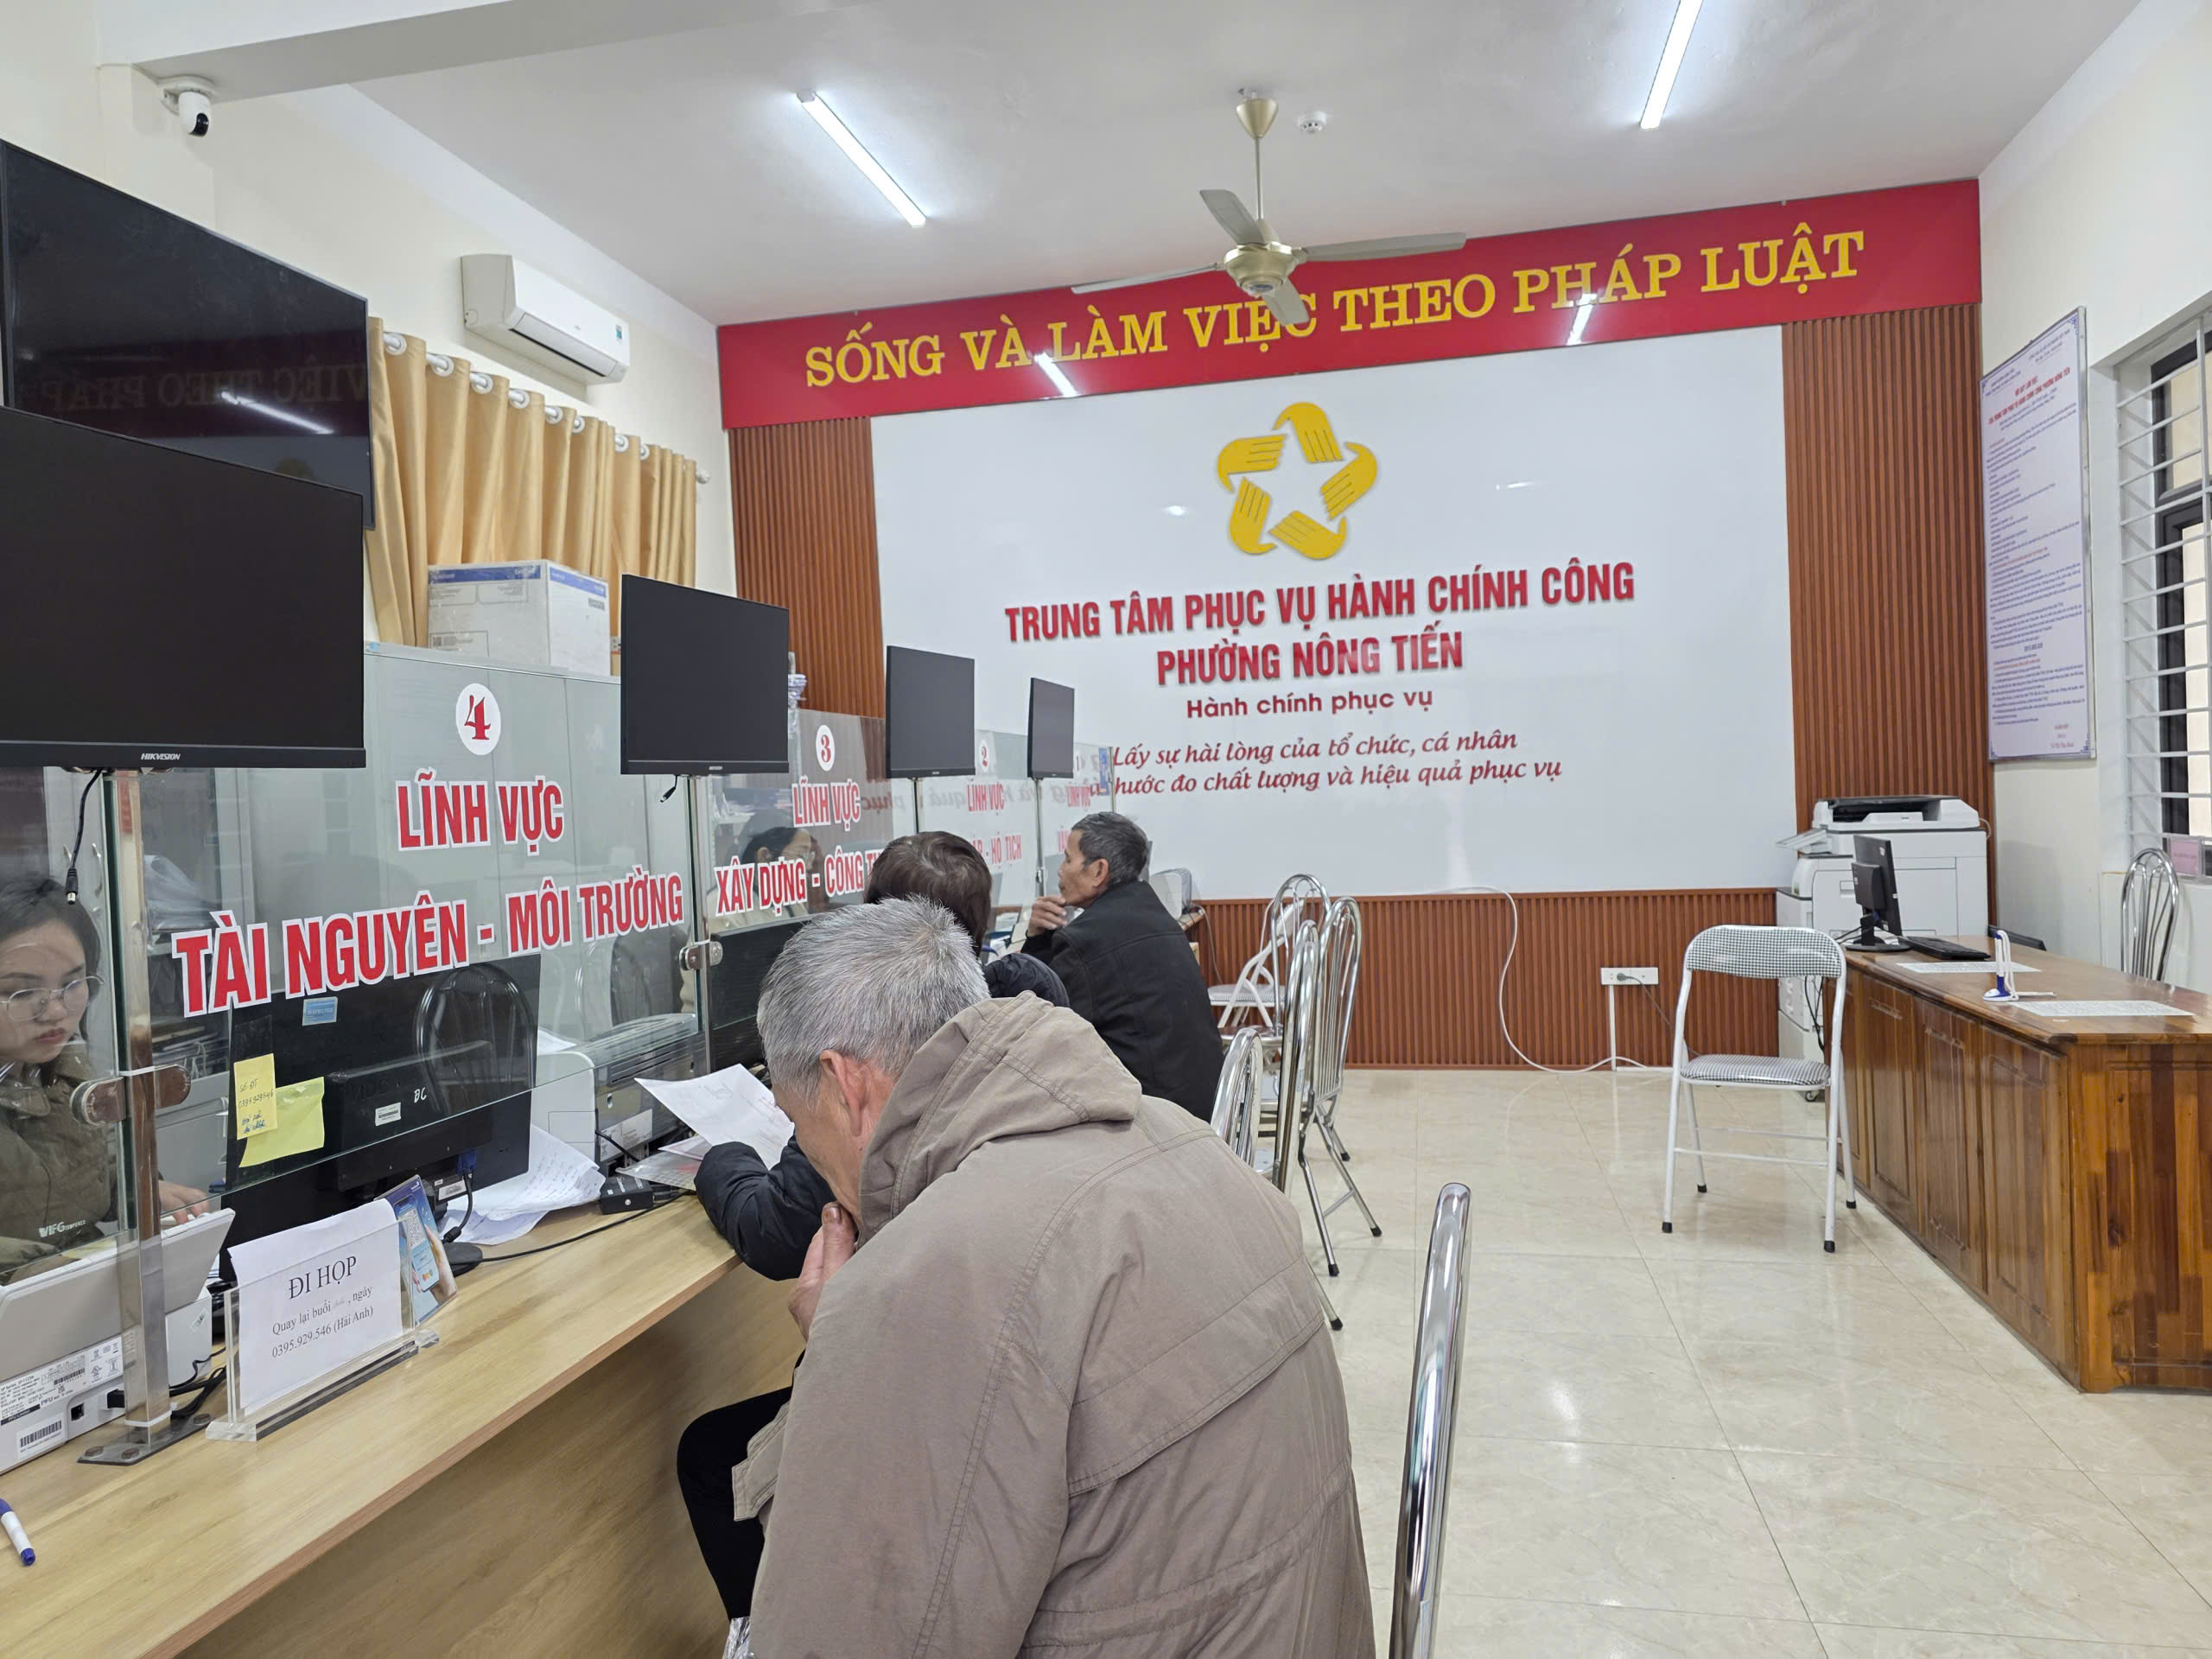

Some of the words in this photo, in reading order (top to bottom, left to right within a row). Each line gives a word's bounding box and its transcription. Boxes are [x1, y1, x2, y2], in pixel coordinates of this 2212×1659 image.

[804, 322, 945, 387] SỐNG
[961, 314, 1033, 371] VÀ
[1048, 304, 1167, 363] LÀM
[1333, 274, 1496, 332] THEO
[1512, 243, 1681, 315] PHÁP
[1700, 221, 1865, 295] LUẬT
[1004, 601, 1101, 642] TRUNG
[1109, 590, 1173, 635] TÂM
[1185, 589, 1266, 635] PHỤC
[1276, 586, 1316, 630] VỤ
[1327, 573, 1415, 620] HÀNH
[1428, 563, 1529, 613] CHÍNH
[1541, 556, 1635, 605] CÔNG
[1156, 637, 1281, 685] PHƯỜNG
[1293, 632, 1381, 679] NÔNG
[1391, 620, 1463, 672] TIẾN
[464, 695, 492, 741] 4
[1186, 696, 1248, 719] Hành
[1256, 692, 1323, 715] chính
[1332, 690, 1395, 715] phục
[1402, 690, 1433, 712] vụ
[820, 734, 832, 763] 3
[981, 746, 988, 767] 2
[1113, 742, 1150, 769] Lấy
[1155, 747, 1181, 769] sự
[1185, 742, 1222, 764] hài
[1225, 741, 1274, 765] lòng
[1280, 737, 1321, 759] của
[1328, 732, 1354, 757] tổ
[1355, 733, 1416, 758] chức,
[1421, 731, 1451, 753] cá
[1456, 728, 1518, 752] nhân
[1114, 774, 1166, 795] hước
[1170, 773, 1198, 792] đo
[1203, 766, 1253, 791] chất
[1257, 770, 1321, 793] lượng
[1327, 766, 1355, 786] và
[1360, 764, 1410, 789] hiệu
[1417, 759, 1463, 786] quả
[1469, 760, 1528, 785] phục
[1534, 760, 1562, 782] vụ
[397, 768, 490, 850] LĨNH
[496, 776, 563, 855] VỰC
[792, 776, 830, 827] LĨNH
[830, 779, 861, 831] VỰC
[715, 856, 754, 916] XÂY
[758, 856, 807, 916] DỰNG
[812, 874, 820, 887] -
[824, 845, 864, 897] CÔNG
[172, 911, 270, 1016] TÀI
[283, 891, 469, 998] NGUYÊN
[478, 925, 494, 944] -
[506, 877, 572, 957] MÔI
[577, 865, 683, 942] TRƯỜNG
[289, 1272, 311, 1300] ĐI
[317, 1255, 357, 1288] HỌP
[271, 1323, 332, 1358] 0395.929.546
[353, 1306, 374, 1324] Anh)
[272, 1318, 297, 1336] Quay
[299, 1310, 310, 1325] lại
